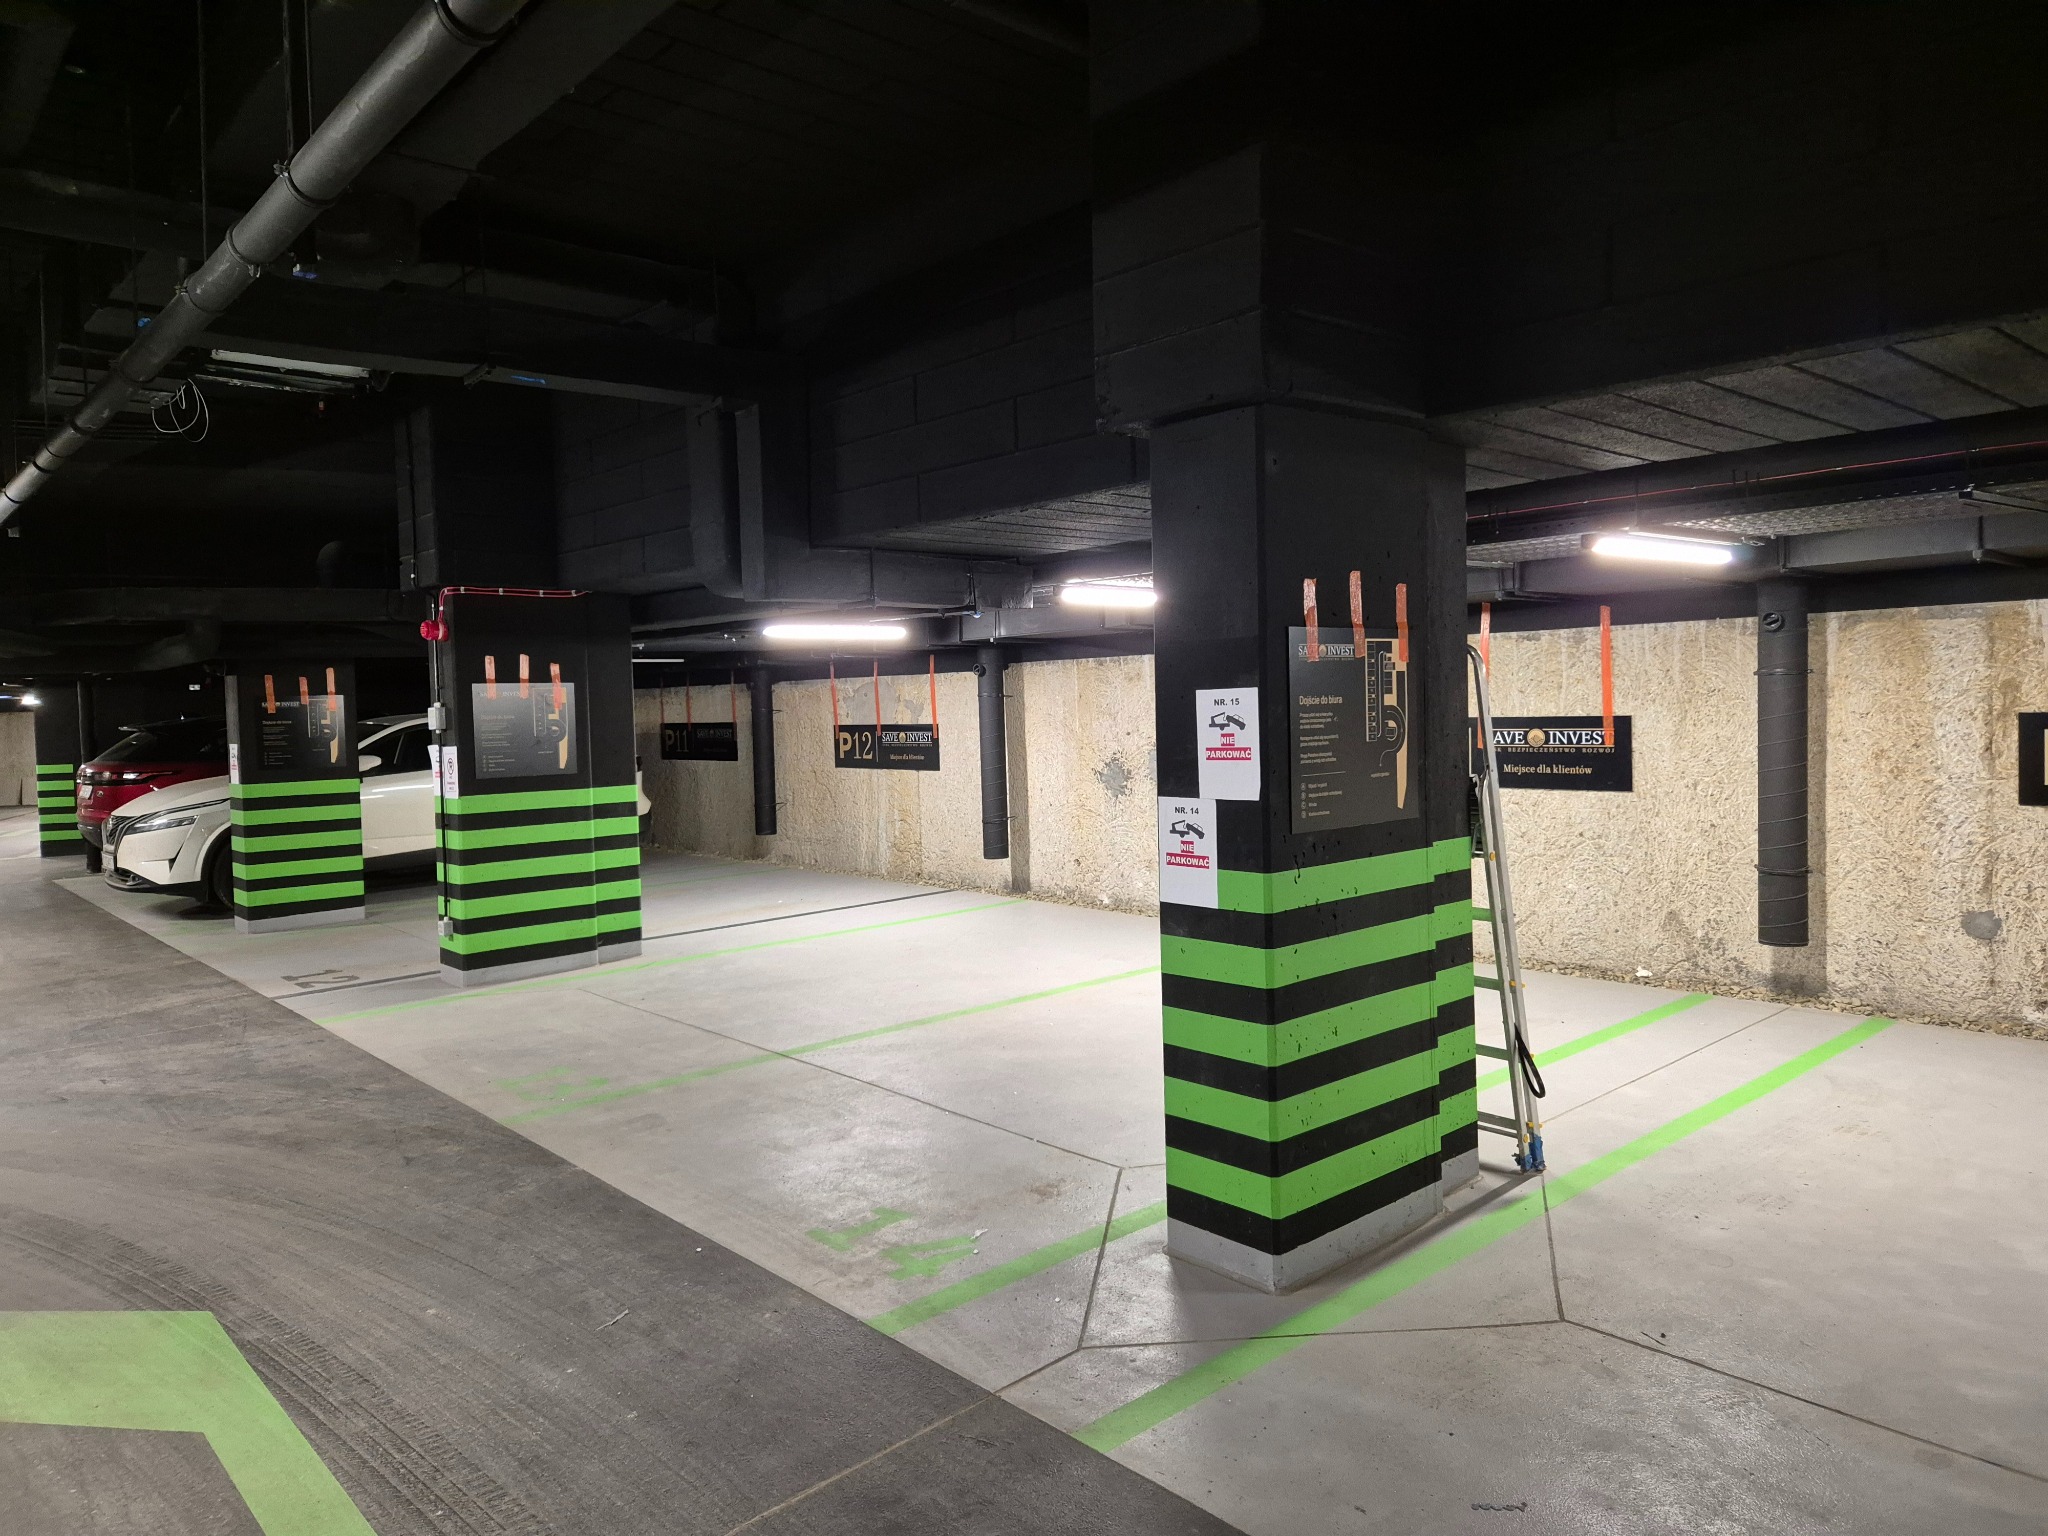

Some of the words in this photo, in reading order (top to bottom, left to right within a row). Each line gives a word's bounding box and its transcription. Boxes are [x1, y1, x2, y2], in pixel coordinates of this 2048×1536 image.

[1327, 645, 1354, 656] INVEST
[1213, 698, 1228, 706] NR.
[1229, 697, 1240, 706] 15
[1299, 695, 1320, 706] Dojście
[1321, 695, 1328, 704] do
[1328, 694, 1343, 704] biura
[665, 729, 689, 752] P11
[882, 732, 898, 742] SAVE
[907, 732, 932, 742] INVEST
[1220, 736, 1235, 745] NIE
[1493, 730, 1525, 745] AVE
[839, 731, 873, 759] P12
[1206, 748, 1252, 759] PARKOWAĆ
[1503, 764, 1536, 775] Miejsce
[1537, 764, 1552, 774] dla
[1553, 765, 1592, 775] klientów
[1174, 806, 1188, 815] NR.
[1189, 807, 1199, 815] 14
[1181, 842, 1194, 852] NIE
[1166, 855, 1210, 867] PARKOWAĆ
[805, 1207, 976, 1281] 14
